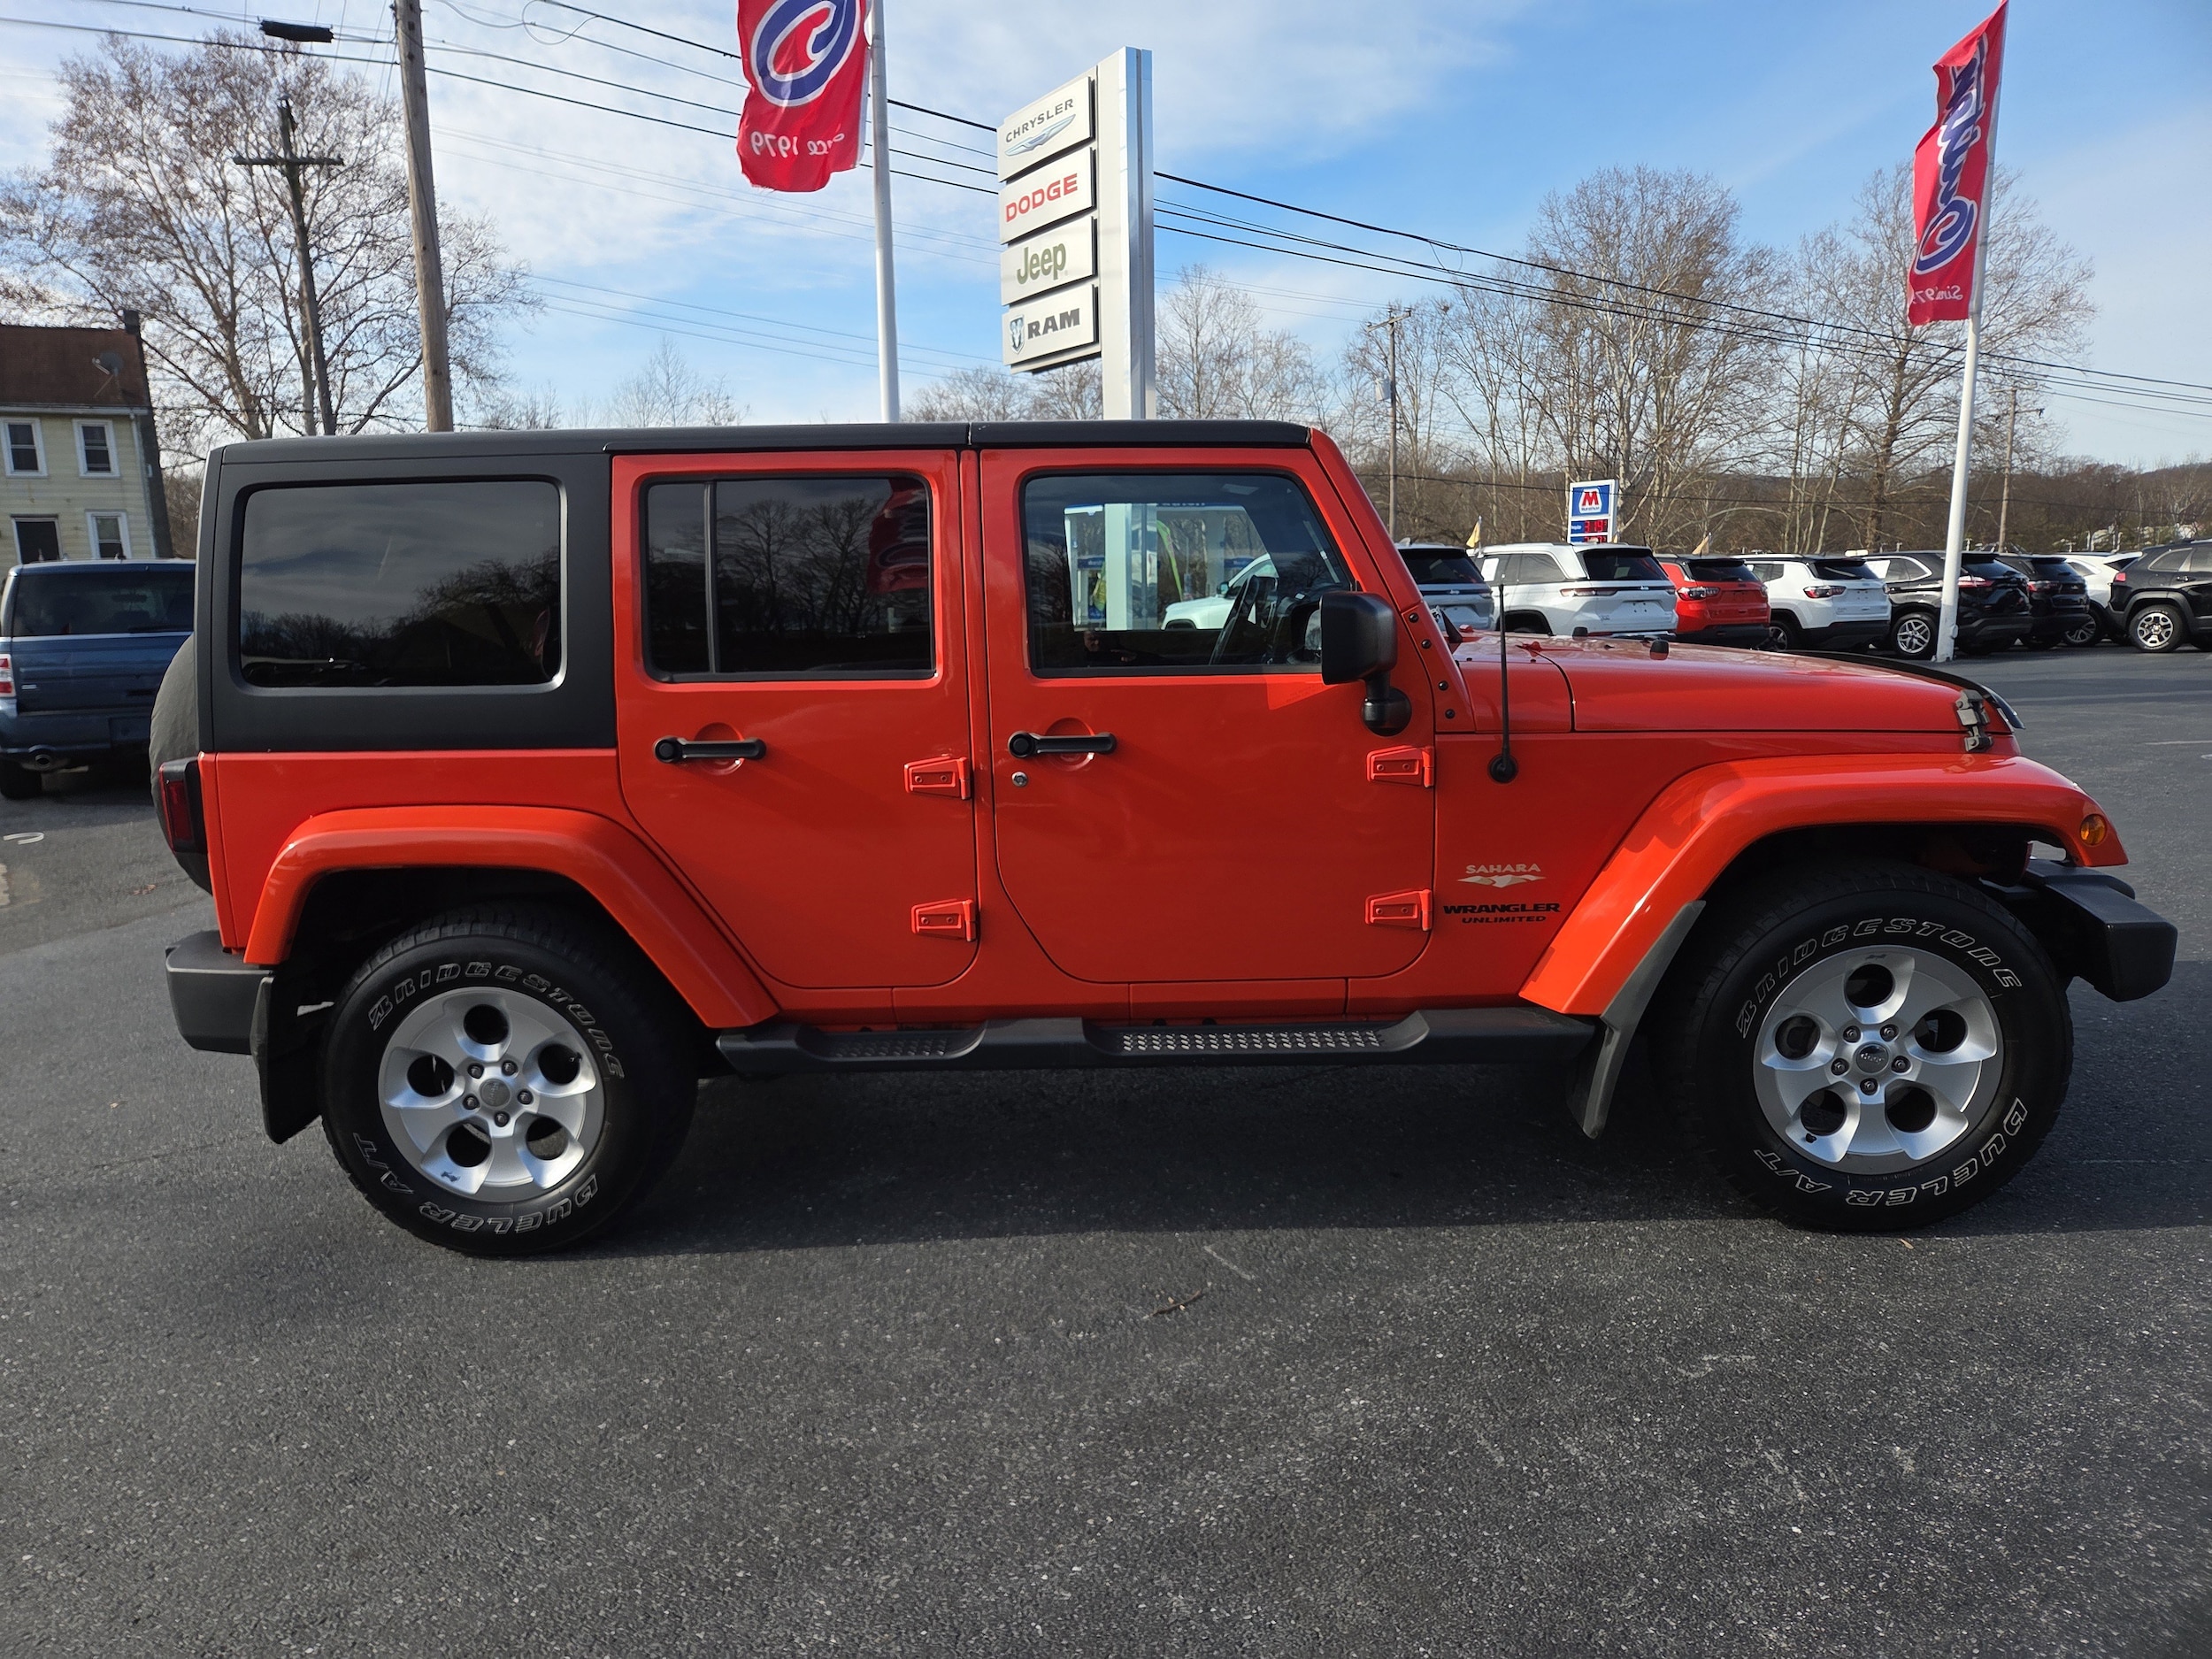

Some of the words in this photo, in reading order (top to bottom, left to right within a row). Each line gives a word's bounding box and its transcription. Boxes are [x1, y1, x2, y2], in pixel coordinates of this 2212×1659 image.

[1005, 98, 1074, 143] CHRYSLER
[1005, 173, 1078, 223] DODGE
[1017, 242, 1067, 285] Jeep
[1027, 308, 1080, 340] RAM
[1581, 490, 1599, 506] M
[1465, 863, 1541, 874] SAHARA
[1443, 902, 1560, 914] WRANGLER
[1462, 915, 1547, 924] UNLIMITED
[1735, 918, 2023, 1039] BRIDGESTONE
[368, 961, 625, 1079] BRIDGESTONE
[1754, 1149, 1832, 1194] A/T
[1846, 1097, 2028, 1207] DUELER
[419, 1173, 599, 1235] DUELER
